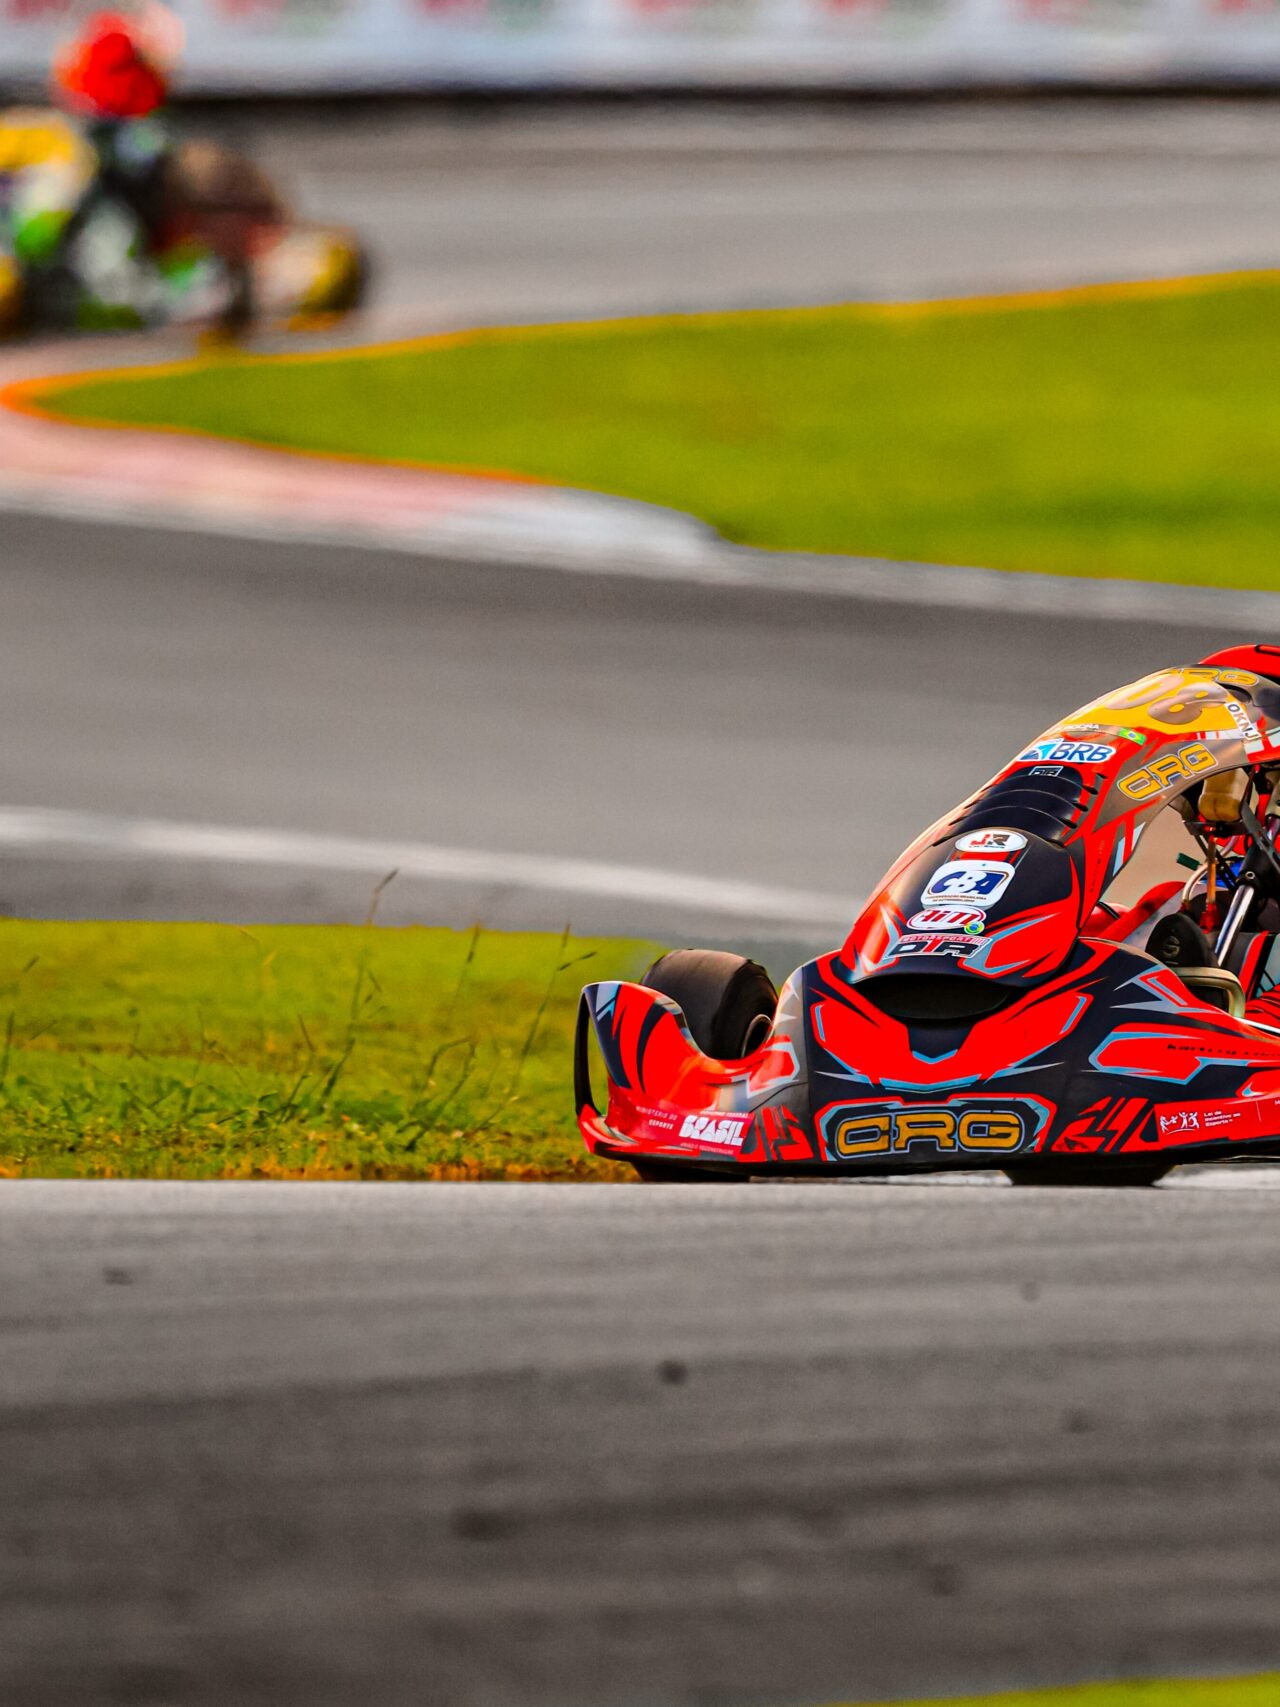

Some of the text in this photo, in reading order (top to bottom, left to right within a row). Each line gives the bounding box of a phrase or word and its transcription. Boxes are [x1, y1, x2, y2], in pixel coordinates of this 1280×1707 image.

[1049, 743, 1113, 761] BRB
[1117, 743, 1218, 800] CRG
[969, 833, 1011, 846] JR
[931, 871, 1005, 895] CBA
[679, 1114, 744, 1146] BRASIL
[837, 1110, 1022, 1157] CRG
